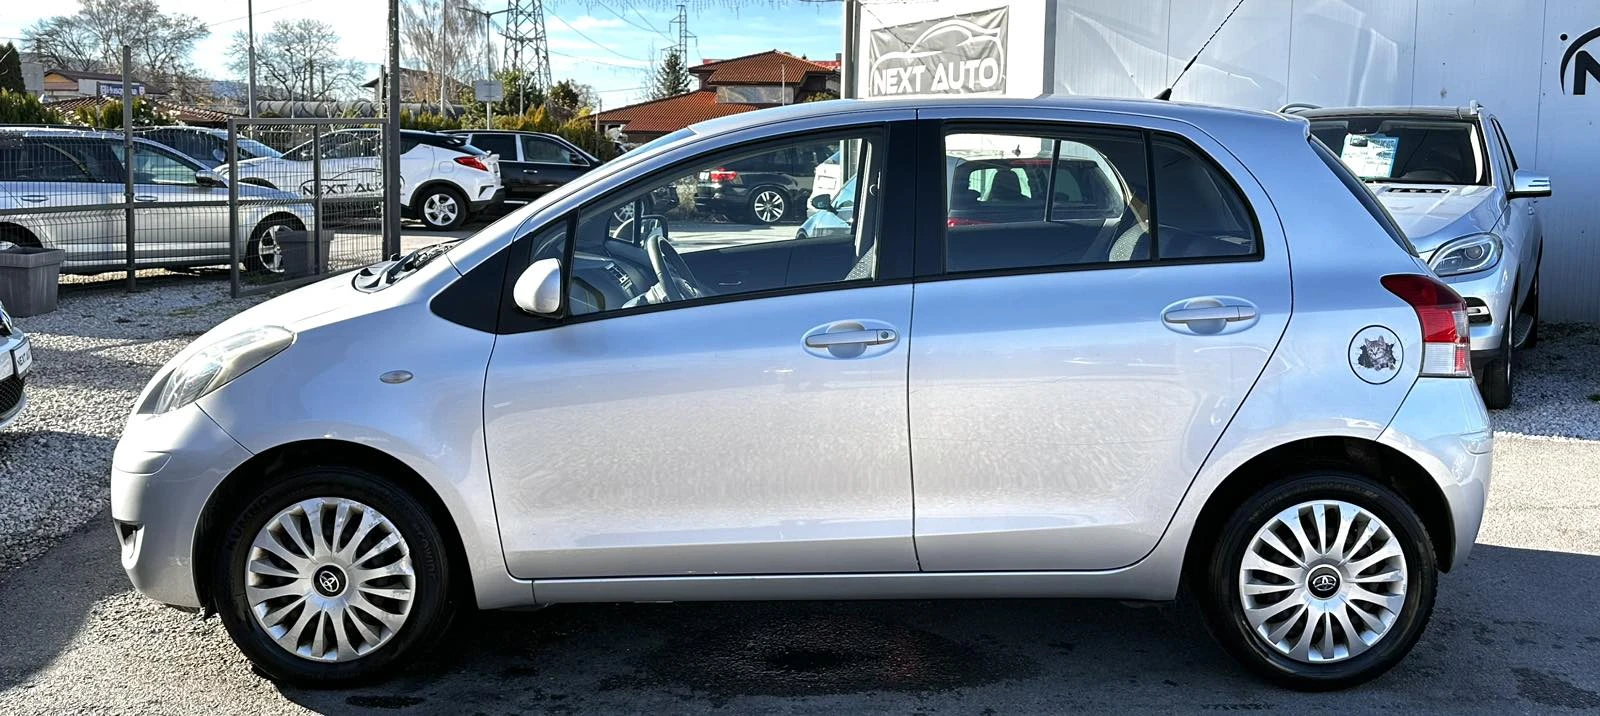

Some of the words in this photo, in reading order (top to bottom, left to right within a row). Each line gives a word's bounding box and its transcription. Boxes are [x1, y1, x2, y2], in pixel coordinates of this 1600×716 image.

[873, 65, 926, 96] NEXT
[931, 57, 999, 92] AUTO
[302, 183, 347, 196] NXT
